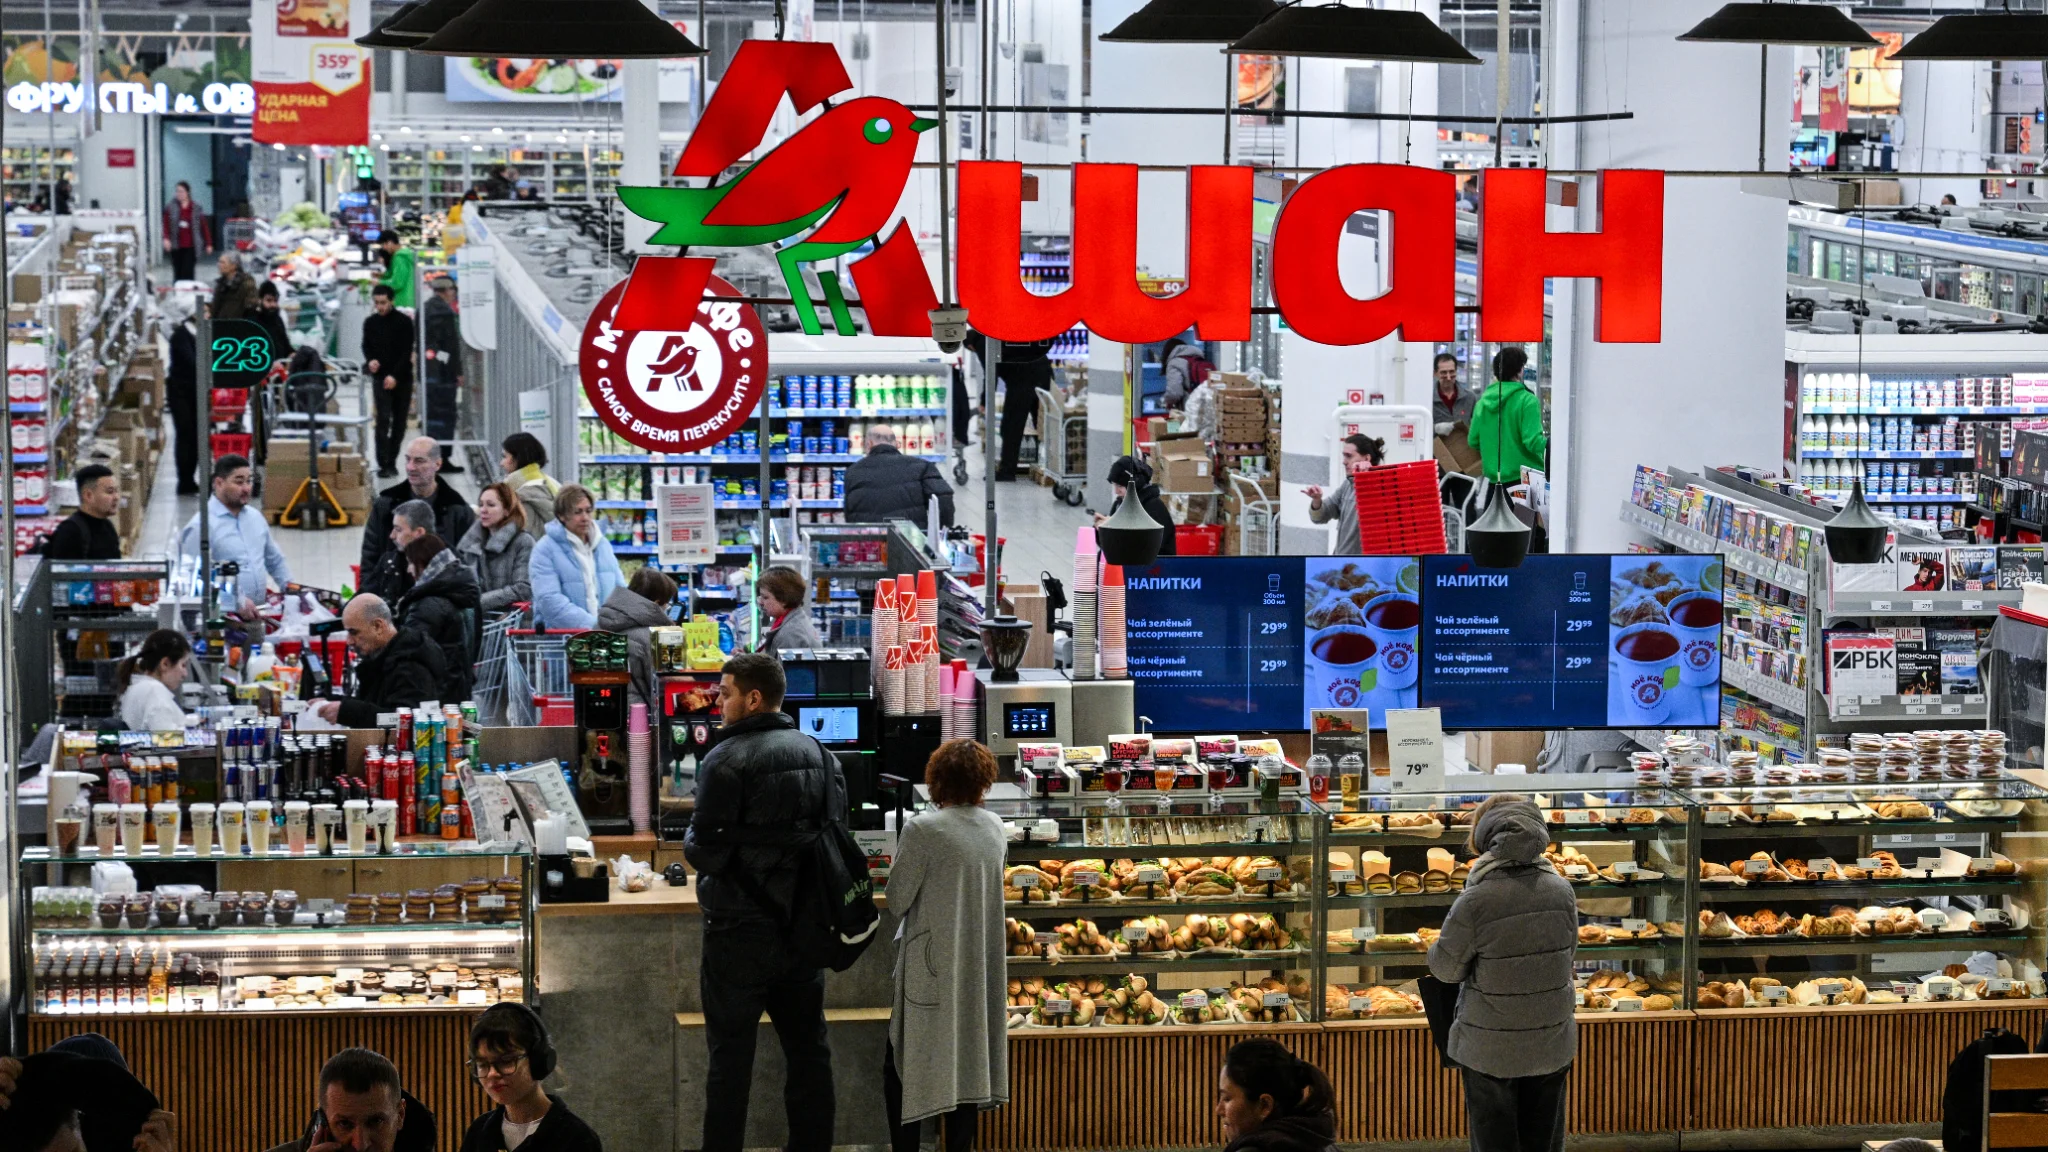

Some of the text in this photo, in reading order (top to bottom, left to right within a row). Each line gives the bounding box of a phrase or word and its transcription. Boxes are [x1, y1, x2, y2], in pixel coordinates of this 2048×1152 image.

[6, 81, 169, 113] ФРУКТЫ
[259, 94, 329, 108] УДАРНАЯ
[258, 109, 299, 124] ЦЕНА
[211, 336, 271, 372] 23
[597, 373, 751, 443] САМОЕ ВРЕМЯ ПЕРЕКУСИТЬ
[1900, 552, 1917, 562] MEN
[1918, 552, 1943, 562] TODAY
[1128, 577, 1202, 590] НАПИТКИ
[1436, 574, 1509, 587] НАПИТКИ
[1128, 618, 1192, 628] Чай зелёный
[1436, 615, 1499, 625] Чай зелёный
[1136, 630, 1203, 640] ассортименте
[1444, 627, 1510, 637] ассортименте
[1127, 655, 1187, 668] Чай чёрный
[1435, 652, 1493, 665] Чай чёрный
[1852, 650, 1893, 669] РБК
[1136, 669, 1203, 679] ассортименте
[1443, 666, 1510, 676] ассортименте
[1344, 678, 1361, 690] каф
[1647, 675, 1665, 688] каф
